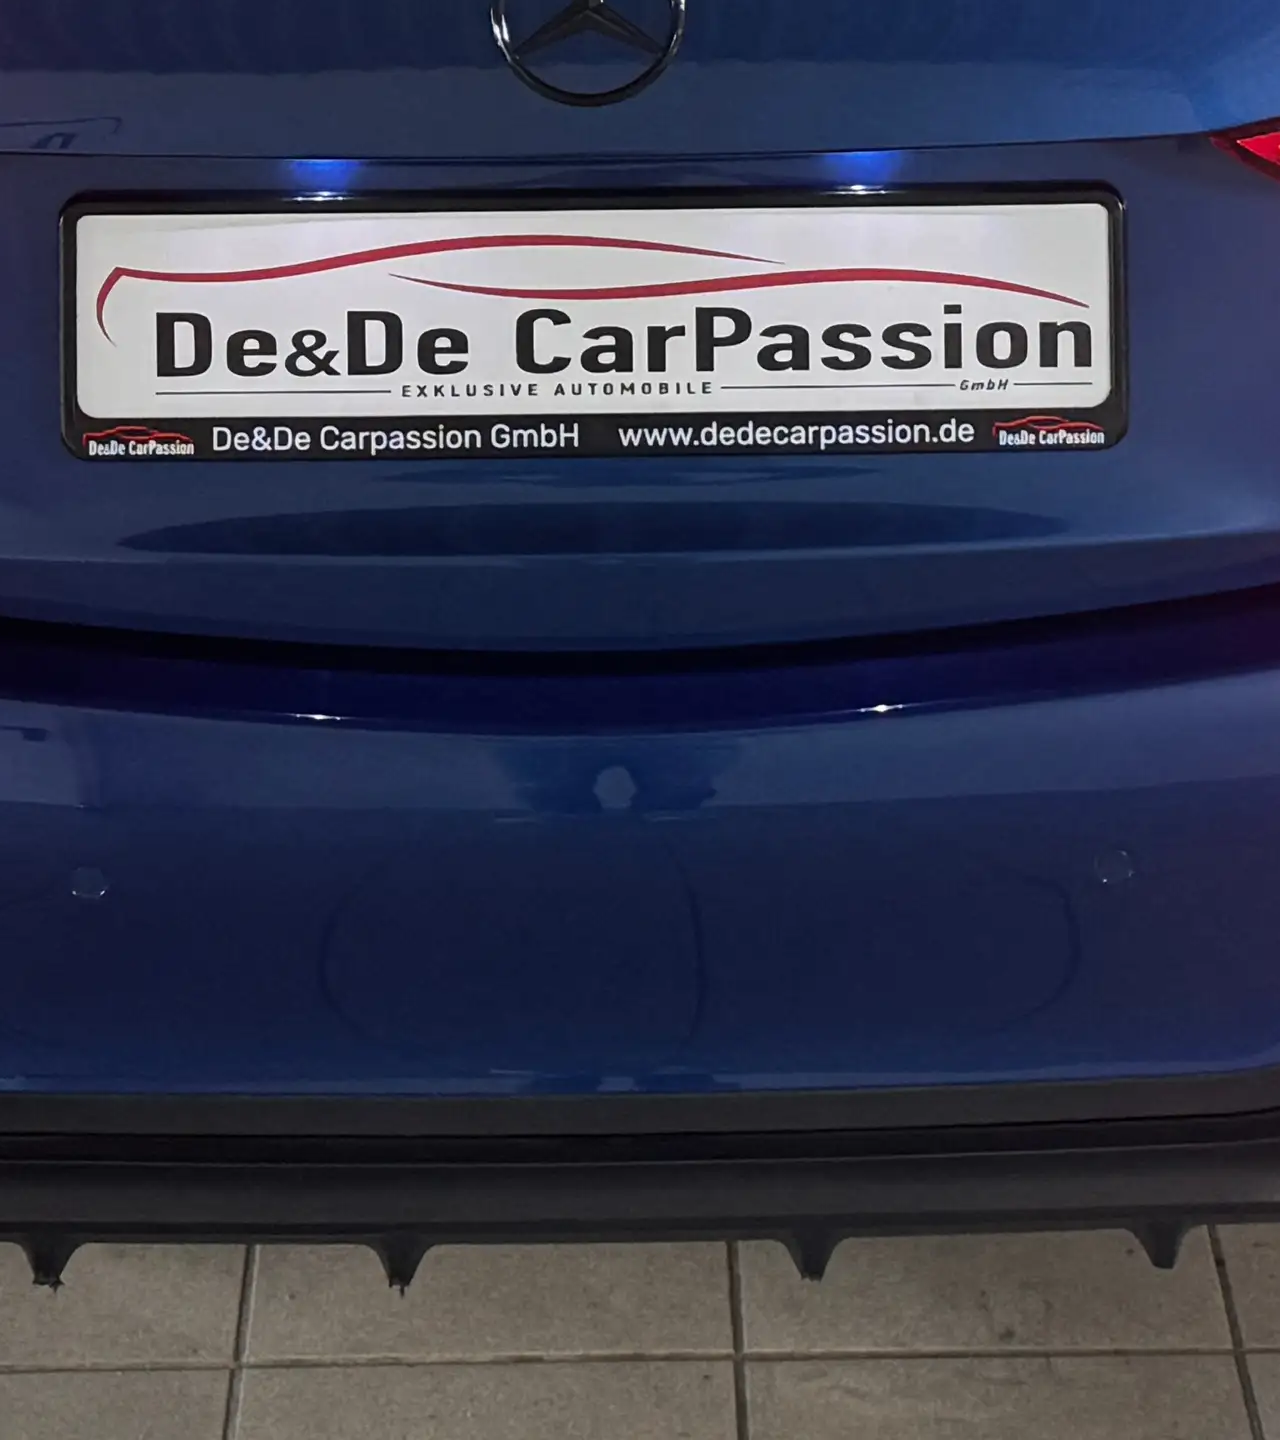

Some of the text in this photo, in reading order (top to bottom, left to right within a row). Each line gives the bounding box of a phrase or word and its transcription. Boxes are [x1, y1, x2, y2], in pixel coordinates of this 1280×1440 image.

[155, 304, 1092, 378] De&De CarPassion
[401, 381, 712, 398] EXKLUSIVE AUTOMOBILE
[959, 378, 1009, 391] GmbH
[212, 418, 975, 456] De&De Carpassion GmbH www.dedecarpassion.de
[1038, 427, 1105, 445] CarPassion
[128, 439, 195, 456] CarPassion
